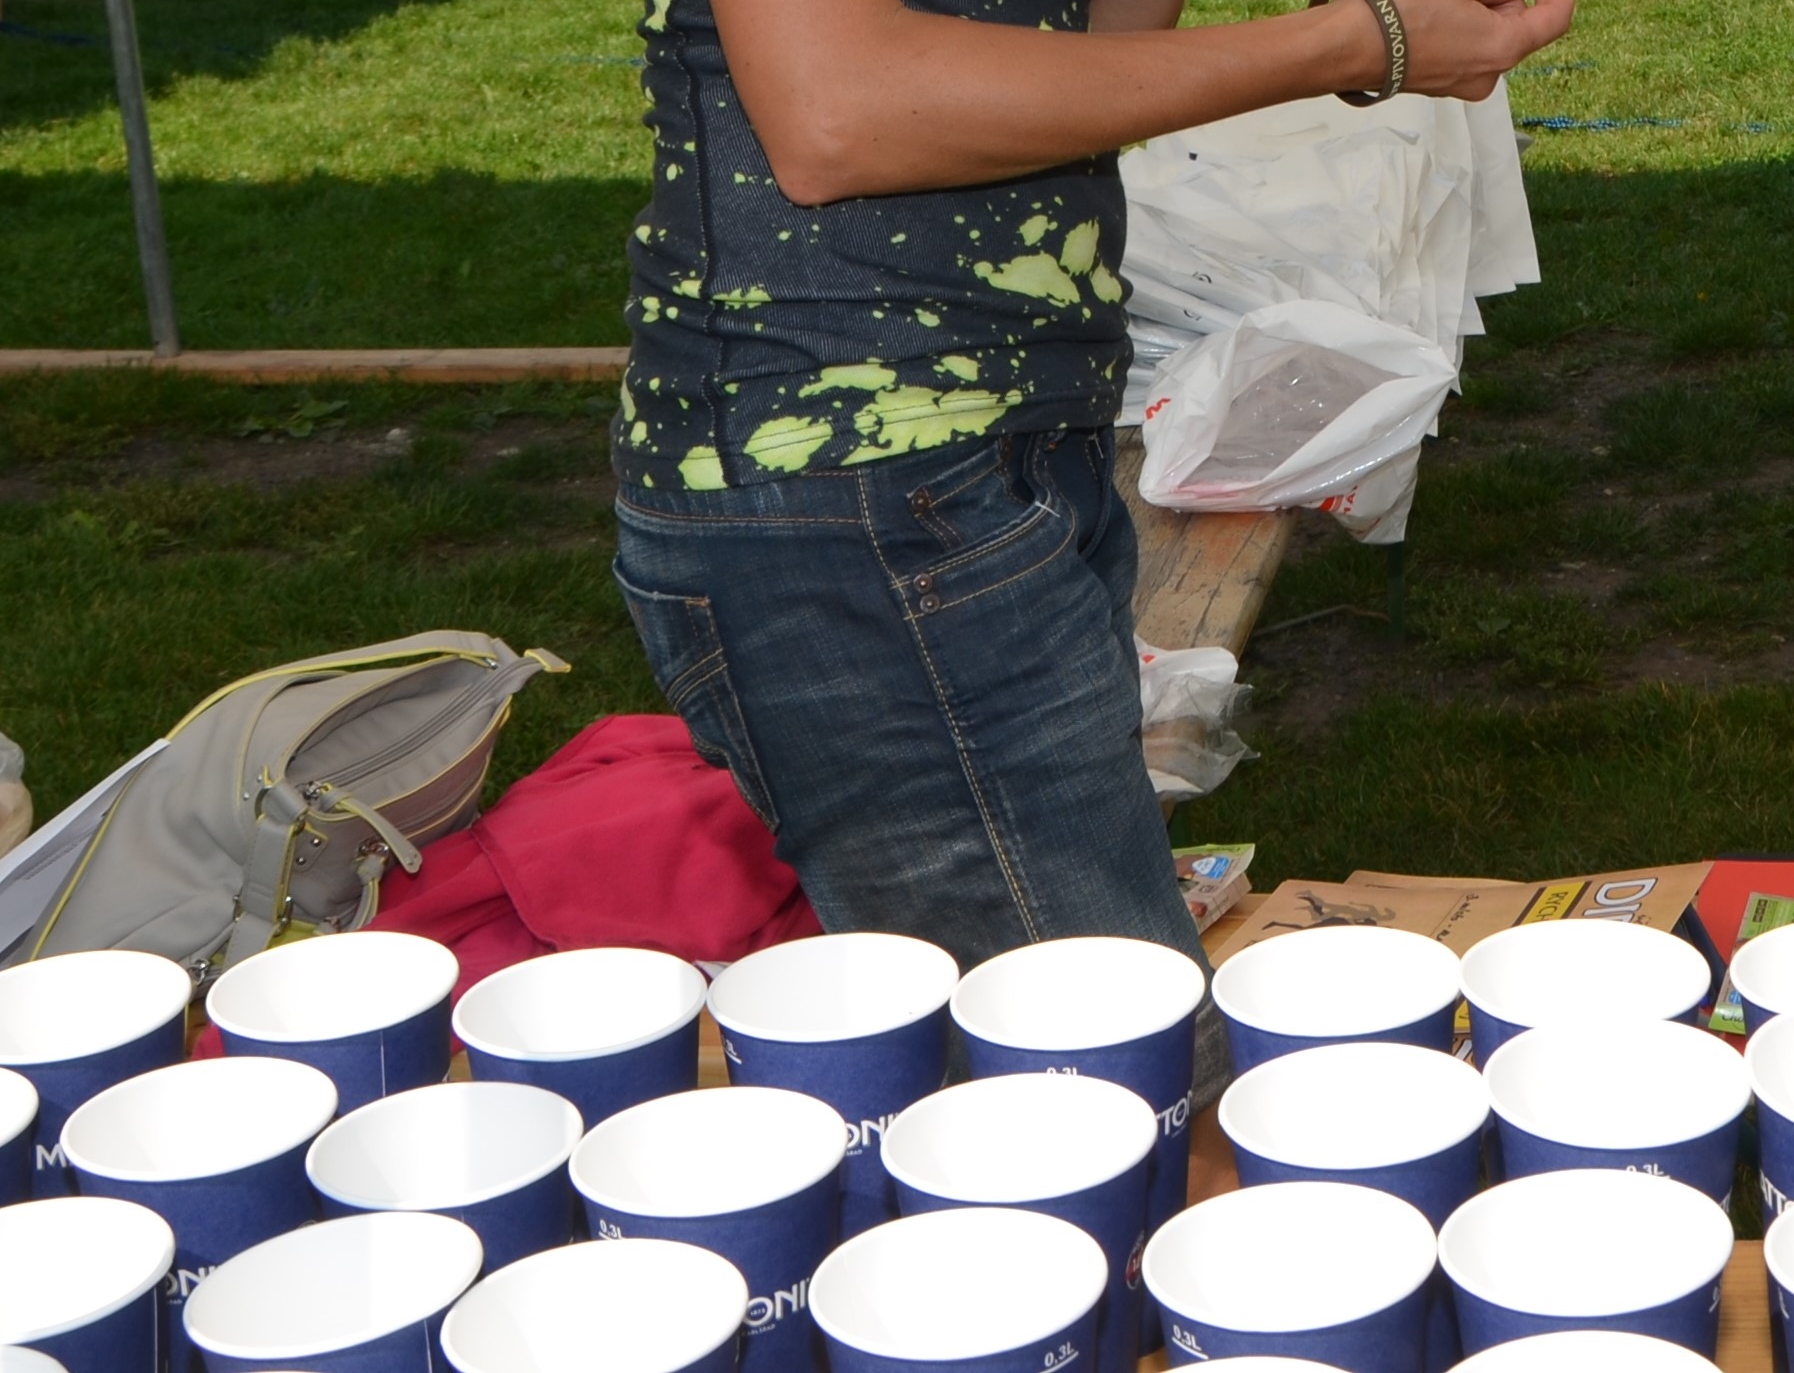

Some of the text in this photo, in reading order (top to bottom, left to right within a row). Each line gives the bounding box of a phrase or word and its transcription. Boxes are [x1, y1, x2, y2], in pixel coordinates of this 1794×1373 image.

[1537, 891, 1566, 921] RYCH
[1173, 1324, 1202, 1352] 0.3L
[1043, 1341, 1075, 1367] 0.3L
